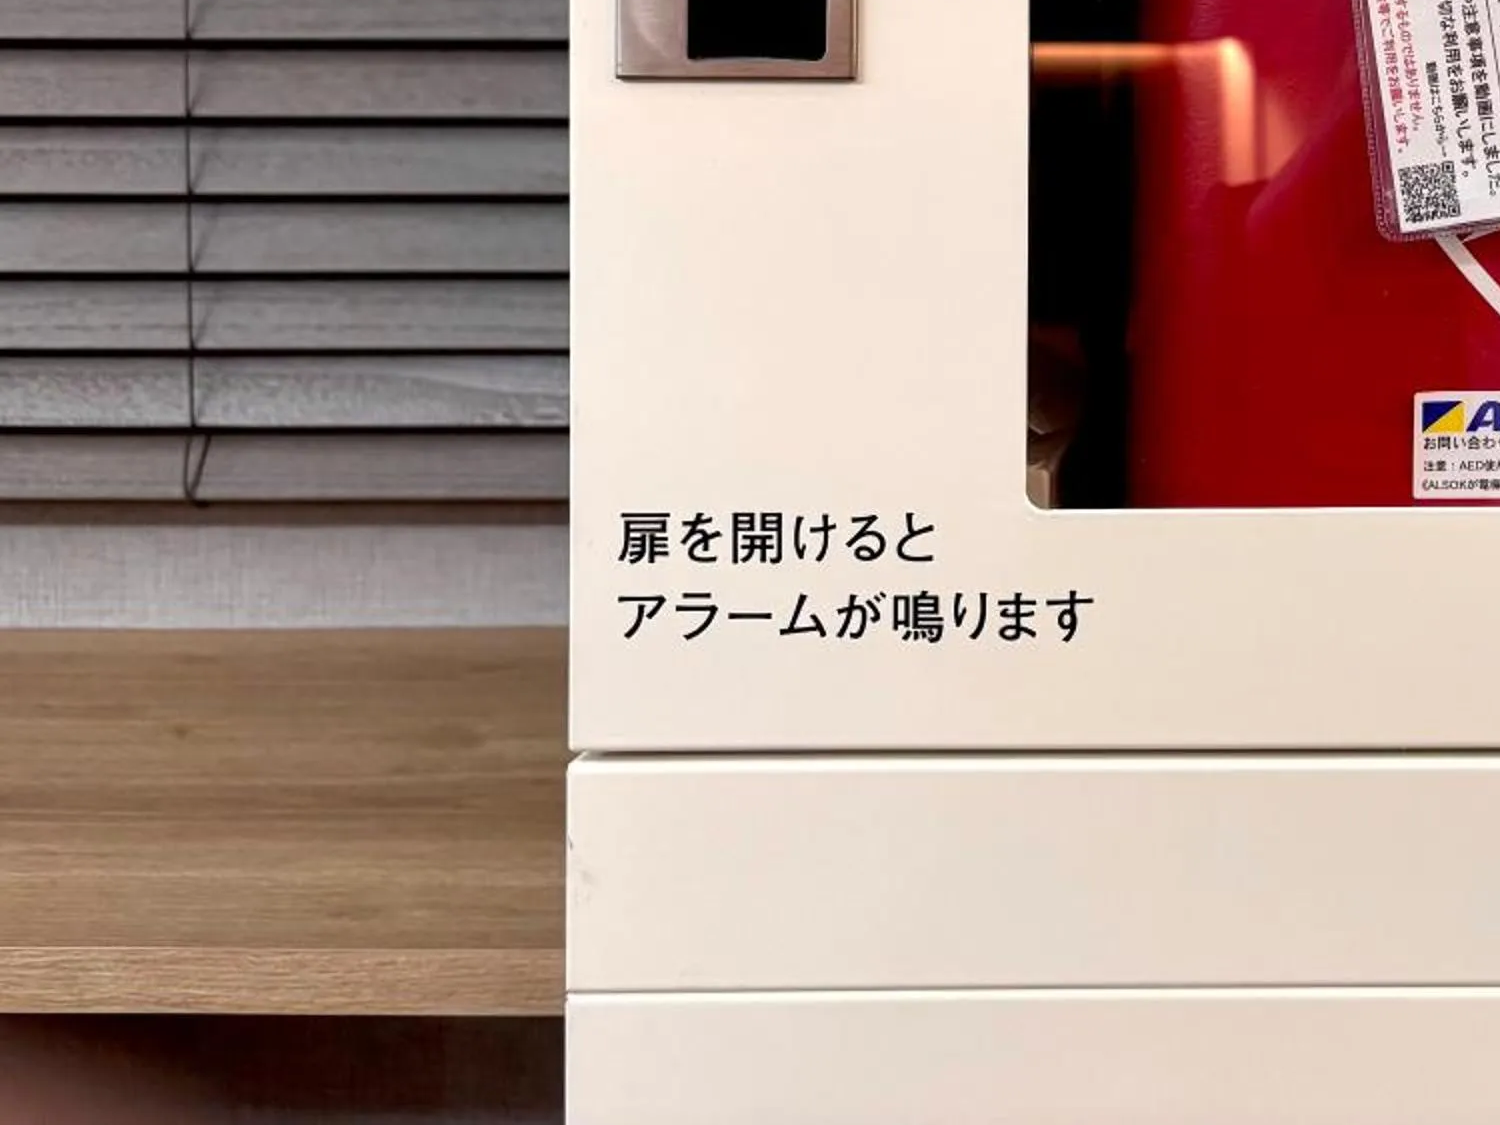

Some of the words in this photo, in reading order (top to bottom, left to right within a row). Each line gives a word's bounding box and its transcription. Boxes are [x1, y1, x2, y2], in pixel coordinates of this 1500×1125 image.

[617, 512, 936, 565] 扉を開けると
[617, 590, 1095, 644] アラームが鳴ります
